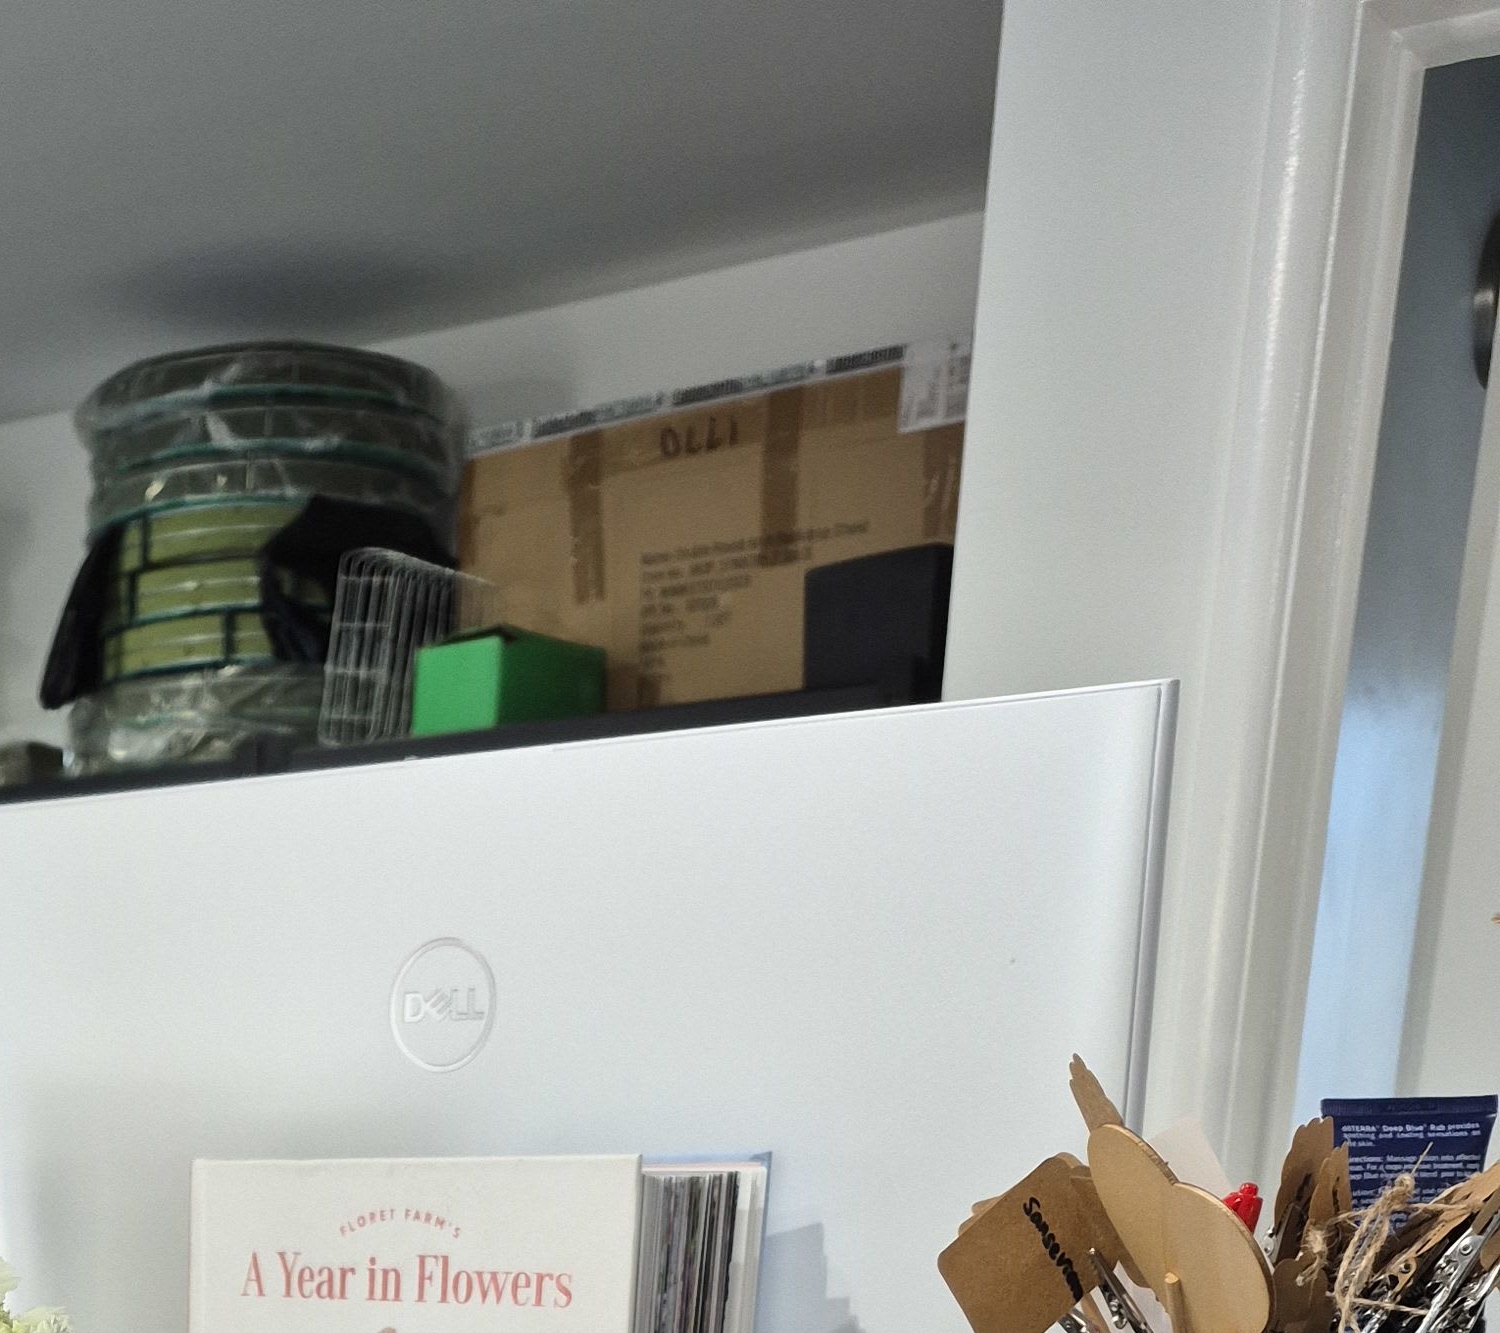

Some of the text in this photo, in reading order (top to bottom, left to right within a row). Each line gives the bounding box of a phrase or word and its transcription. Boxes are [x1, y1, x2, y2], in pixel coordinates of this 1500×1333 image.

[403, 987, 484, 1022] DELL
[339, 1207, 461, 1239] FLORET FARM'S
[241, 1250, 573, 1308] A Year in Flowers
